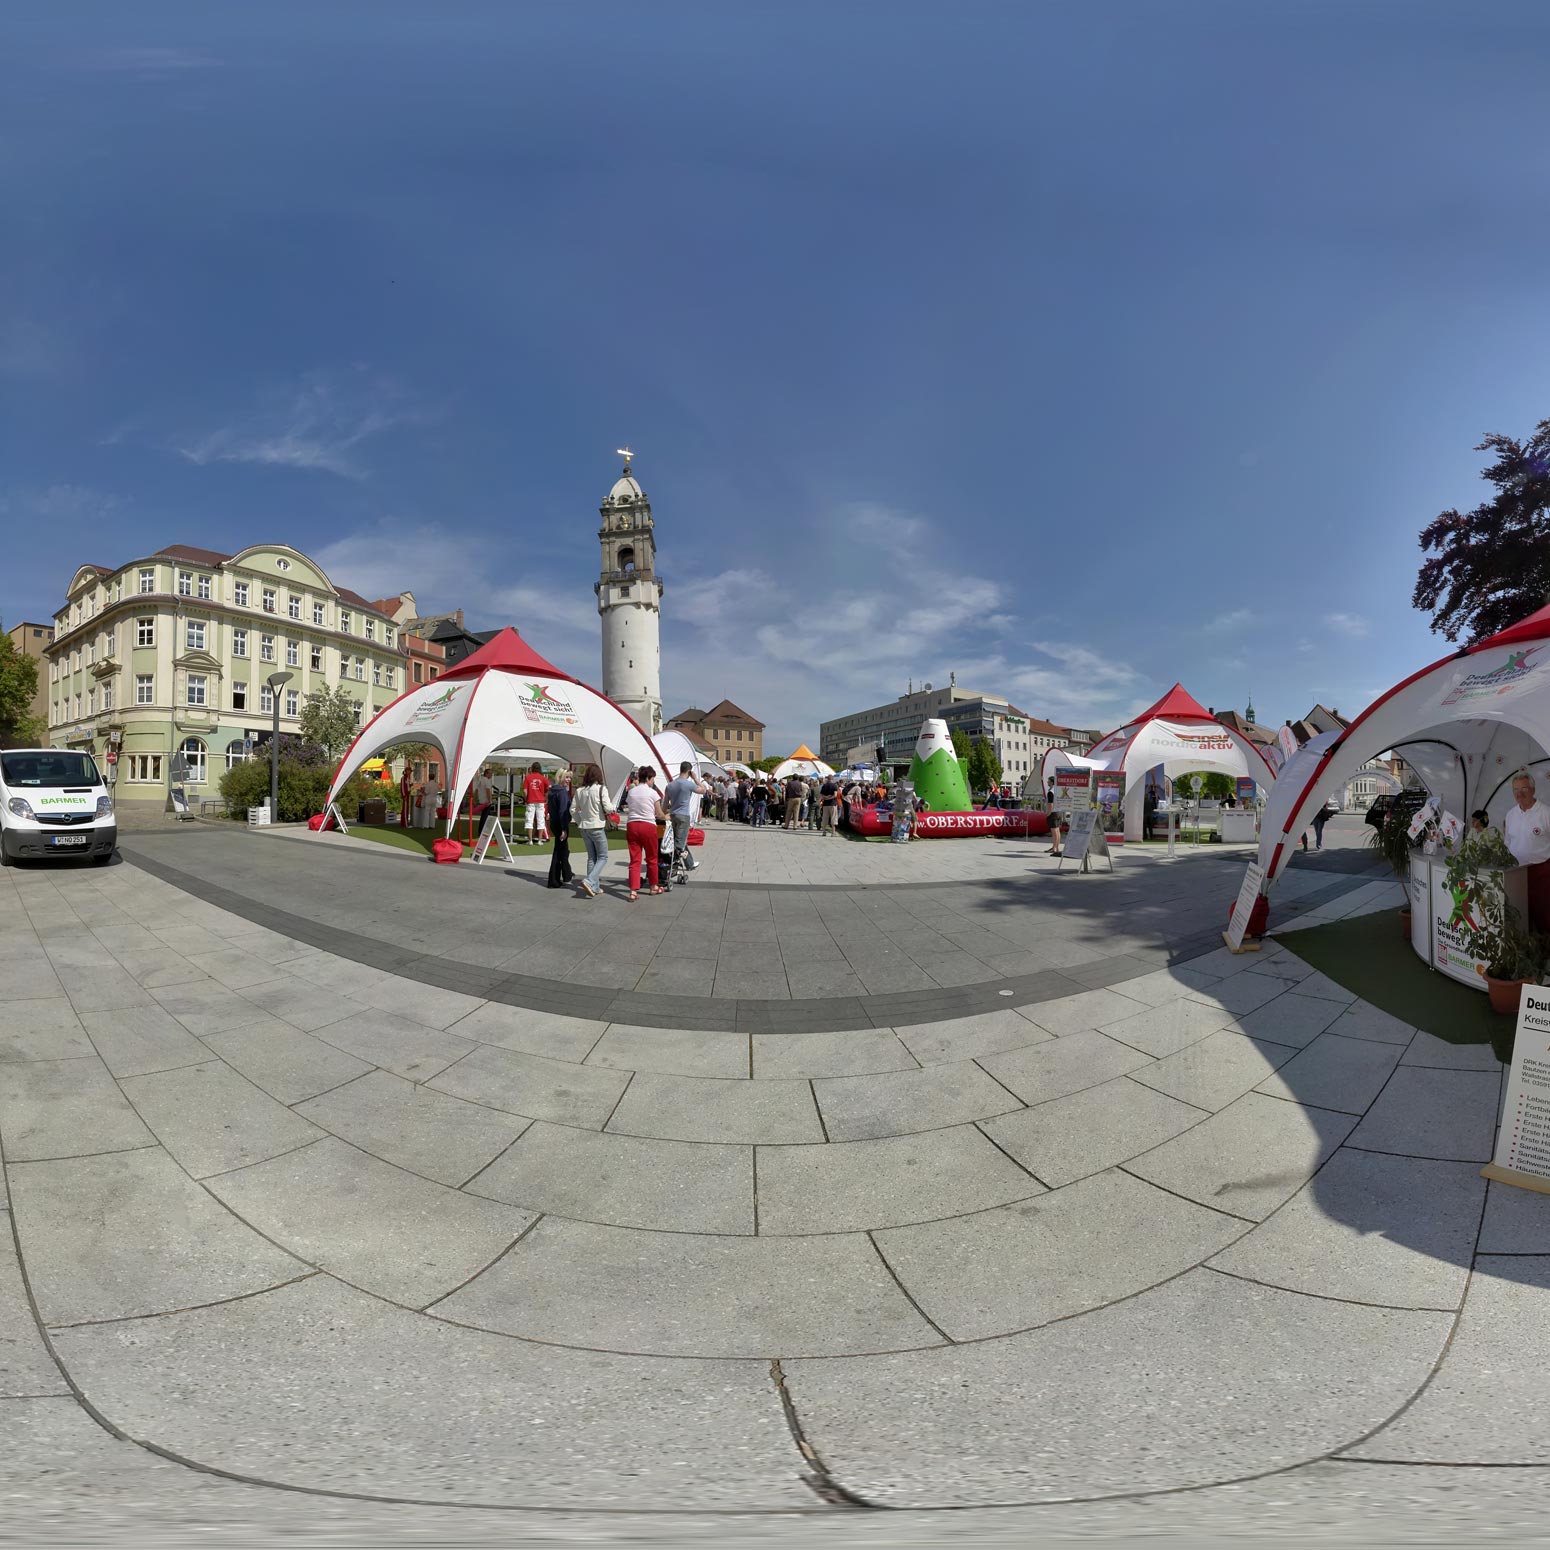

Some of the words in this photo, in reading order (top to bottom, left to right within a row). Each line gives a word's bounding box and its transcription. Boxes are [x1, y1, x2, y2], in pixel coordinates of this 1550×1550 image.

[40, 797, 87, 805] BARMER
[1523, 1058, 1538, 1066] DRK
[1522, 1065, 1547, 1076] Bautzen
[1524, 1112, 1543, 1122] Erste
[1523, 1119, 1543, 1129] Erste
[1522, 1127, 1541, 1137] Erste
[1520, 1135, 1540, 1145] Erste
